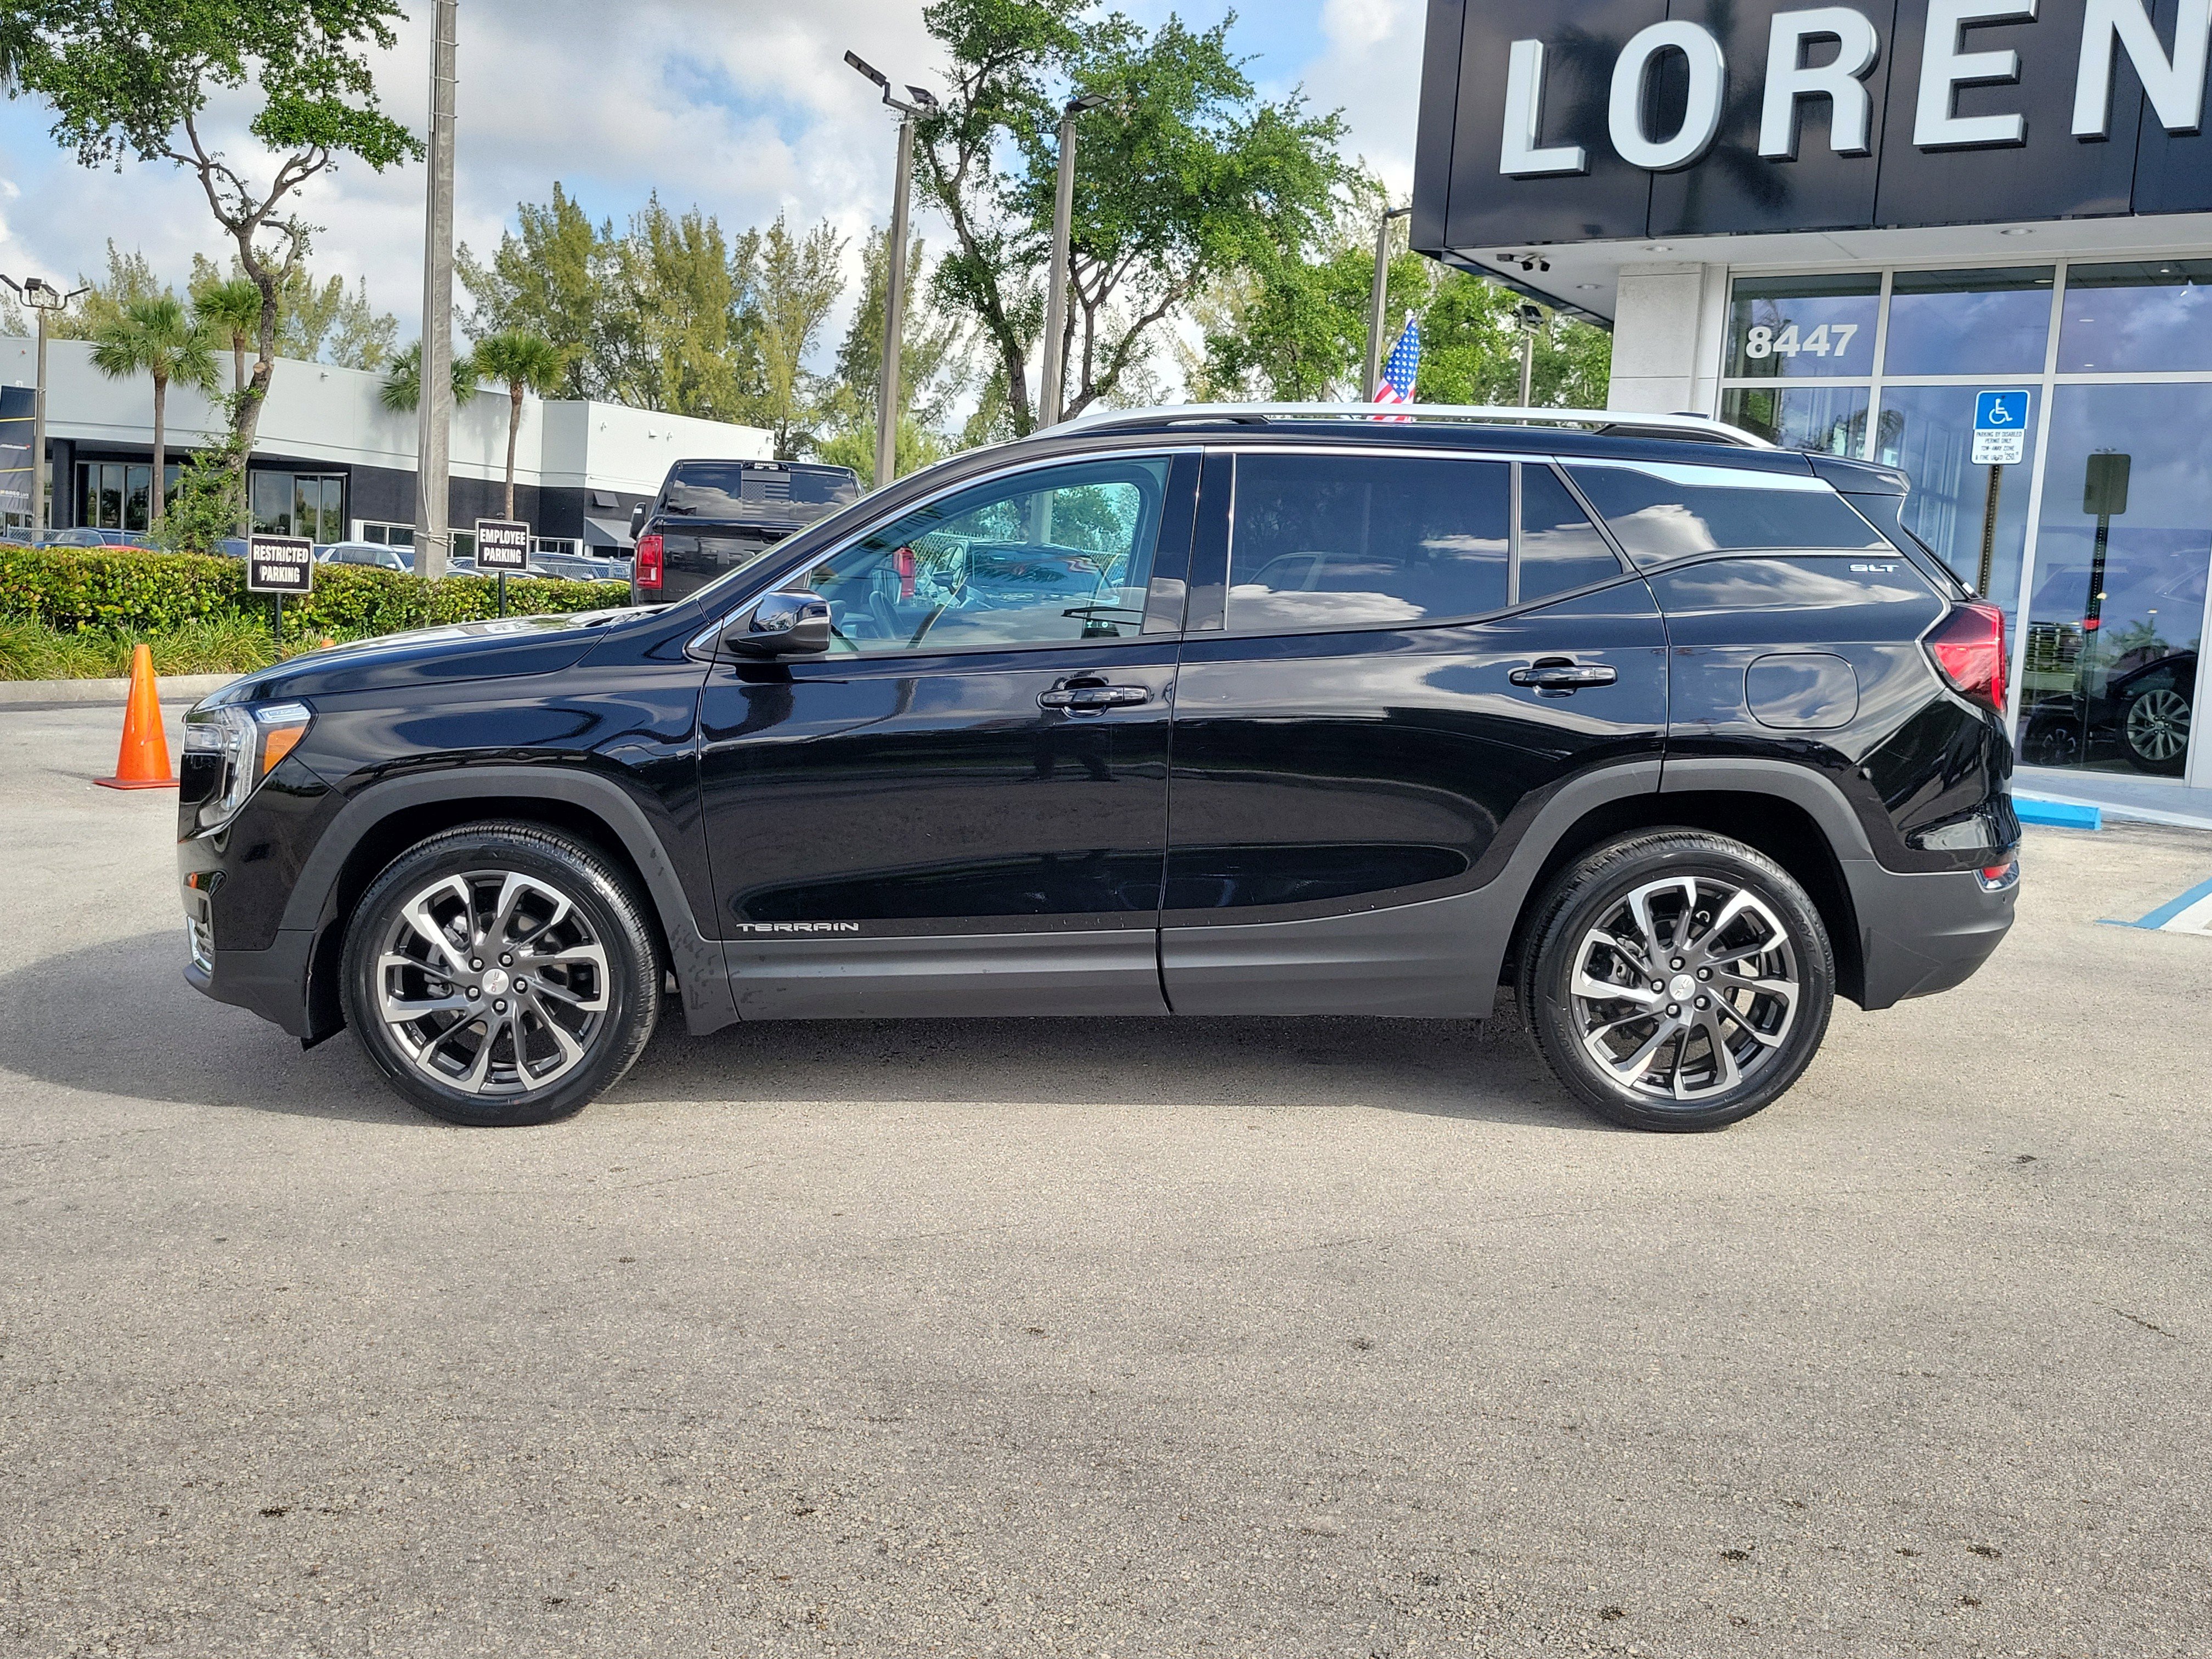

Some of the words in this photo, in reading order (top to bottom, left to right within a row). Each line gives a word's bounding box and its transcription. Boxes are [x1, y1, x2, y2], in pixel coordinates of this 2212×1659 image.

[1499, 0, 2211, 177] LOREN
[1746, 324, 1858, 359] 8447
[479, 528, 526, 546] EMPLOYEE
[253, 544, 309, 563] RESTRICTED
[483, 546, 522, 563] PARKING
[261, 565, 300, 583] PARKING
[1849, 564, 1899, 572] SLT
[736, 922, 859, 932] TERRAIN
